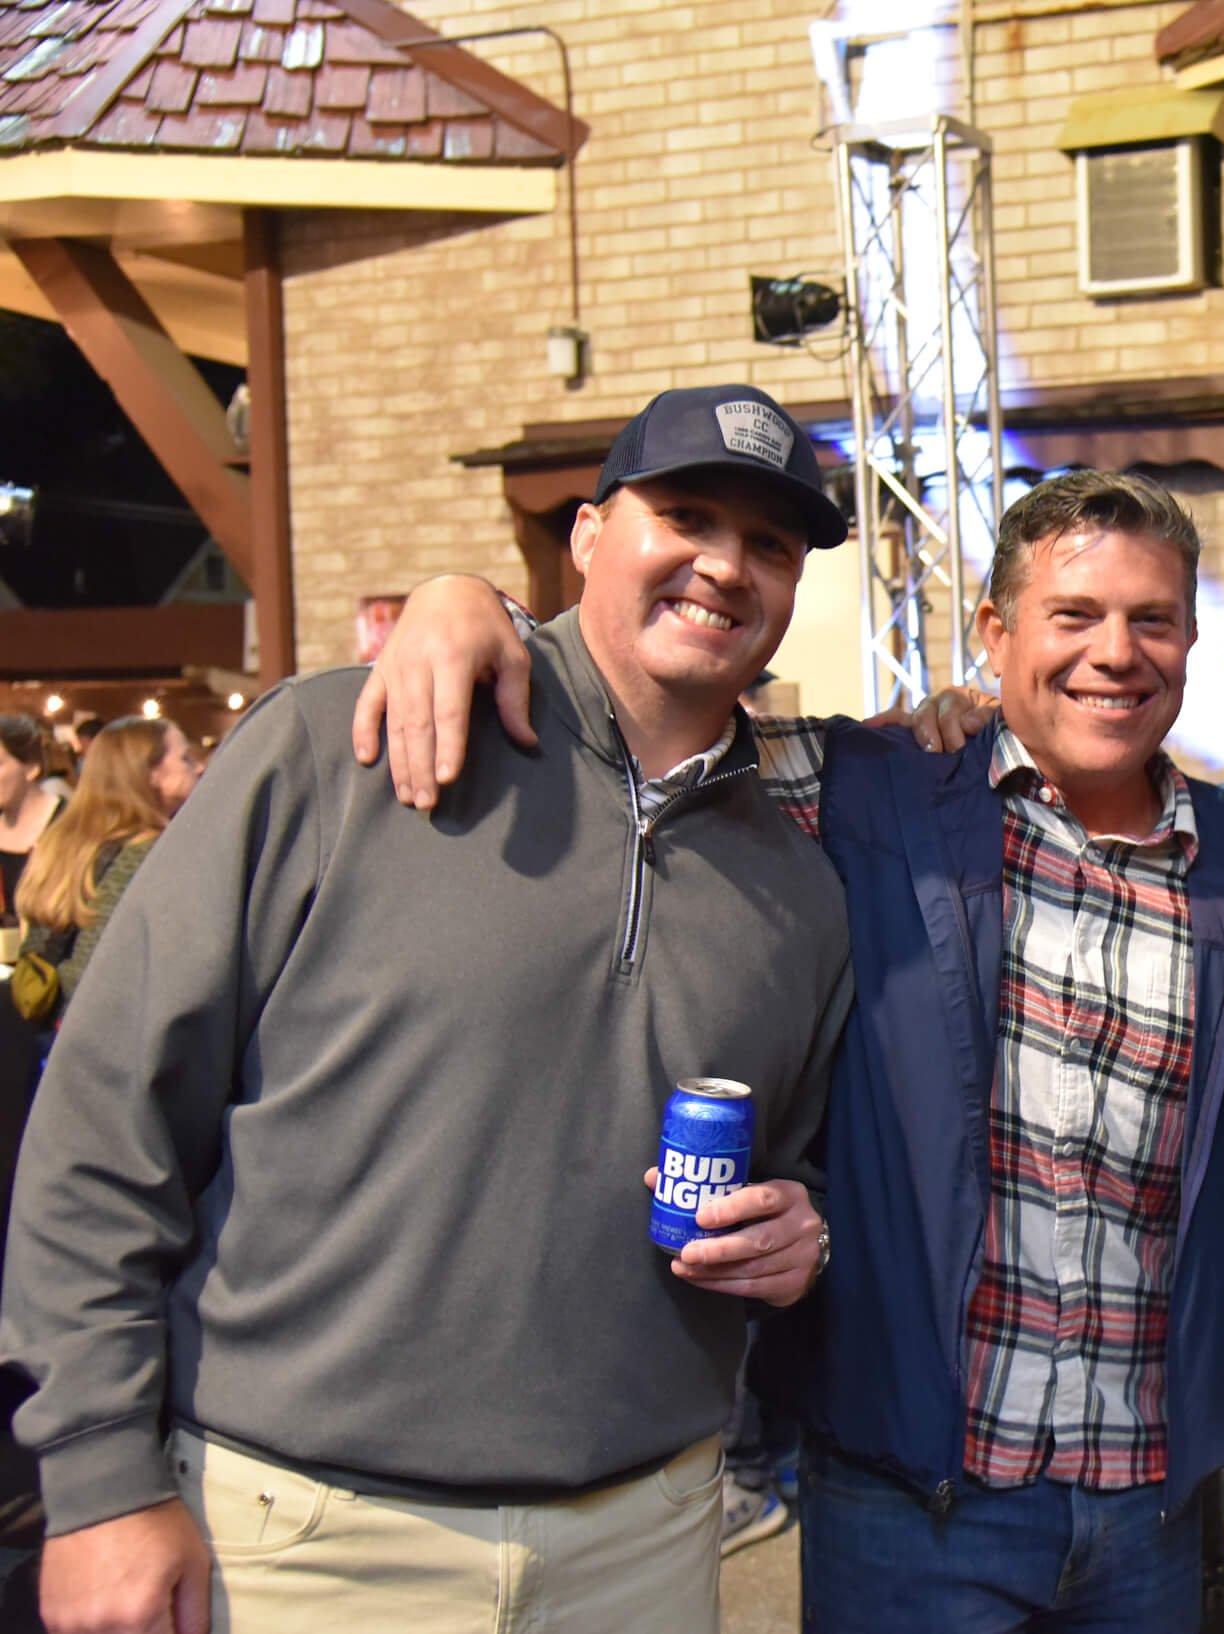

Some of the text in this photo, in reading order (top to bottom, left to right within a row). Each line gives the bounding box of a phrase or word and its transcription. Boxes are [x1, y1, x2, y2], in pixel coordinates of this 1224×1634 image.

[753, 418, 769, 433] CC
[730, 438, 783, 465] CHAMPION
[664, 1148, 735, 1184] BUD
